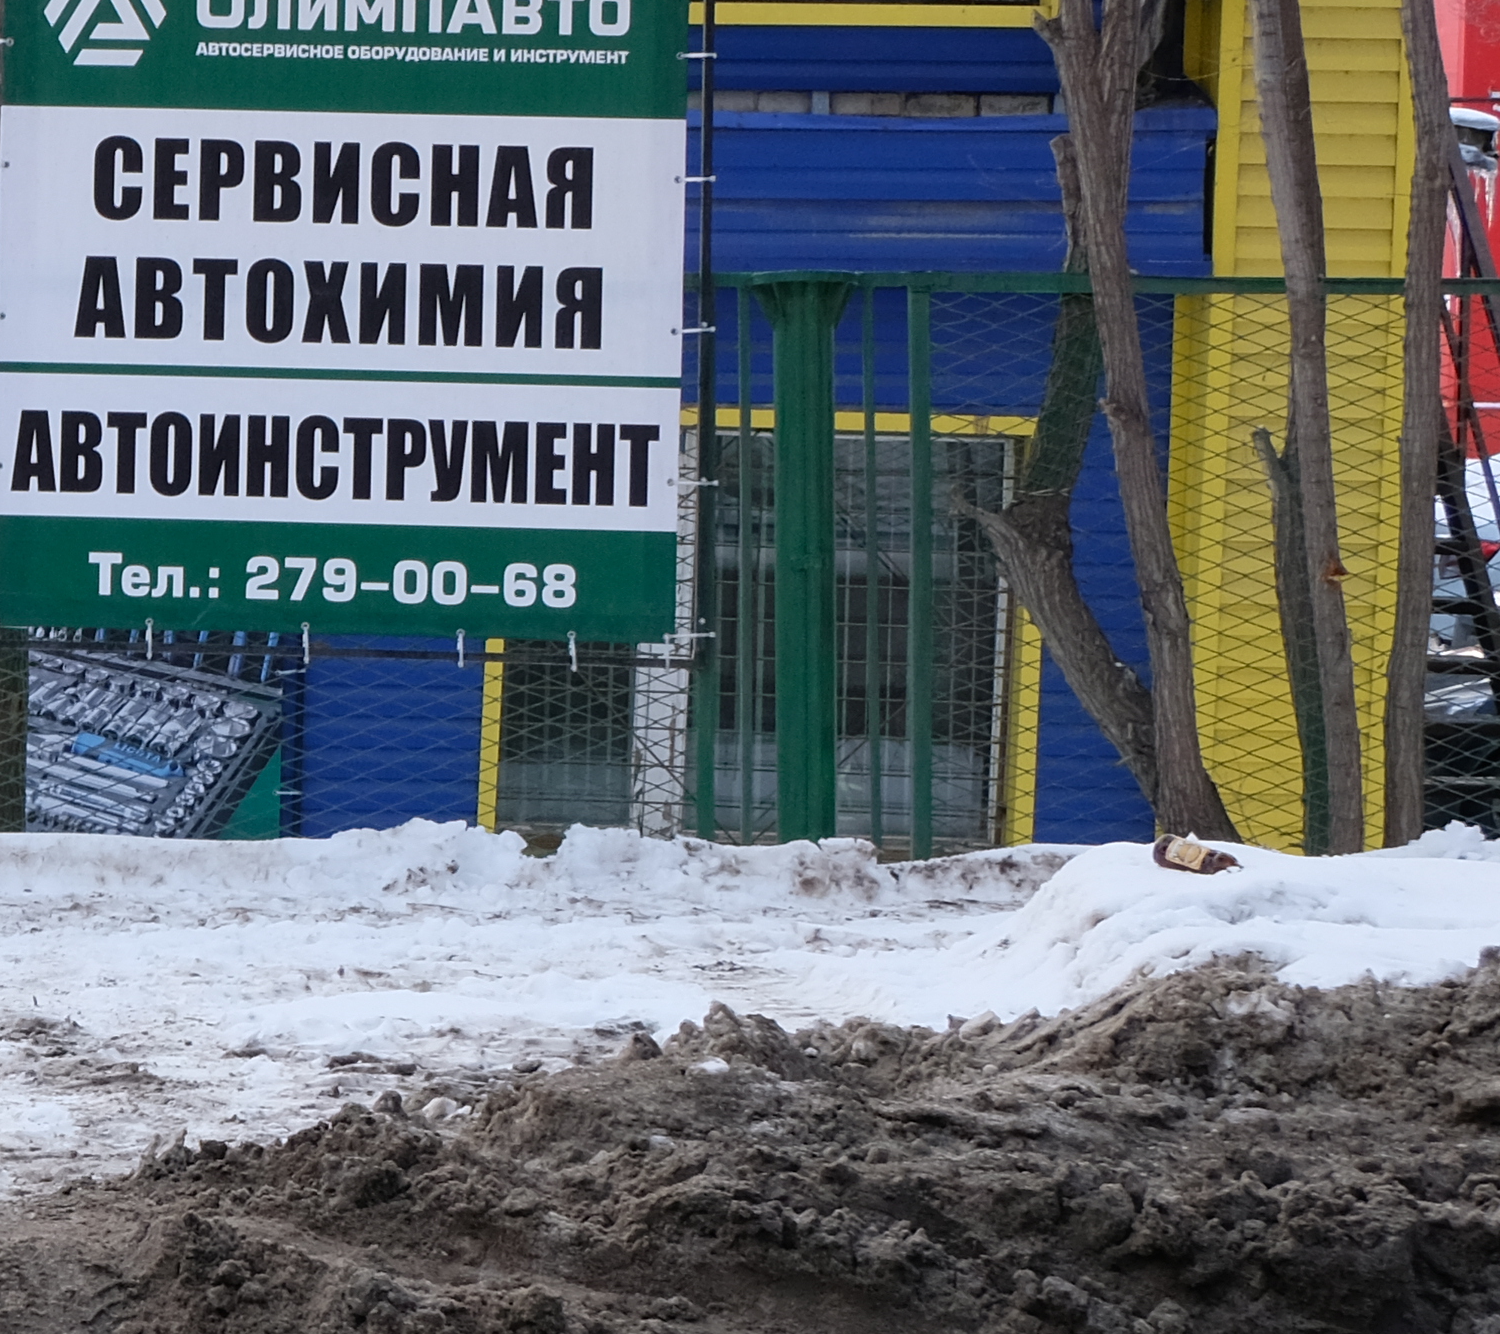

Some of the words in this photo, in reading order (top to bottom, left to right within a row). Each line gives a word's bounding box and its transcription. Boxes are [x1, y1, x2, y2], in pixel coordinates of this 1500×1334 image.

[196, 42, 344, 59] АВТОСЕРВИСНОЕ
[347, 45, 489, 62] ОБОРУДОВАНИЕ
[493, 48, 506, 62] И
[510, 49, 629, 64] ИНСТРУМЕНТ
[93, 135, 594, 230] СЕРВИСНАЯ
[74, 255, 603, 350] АВТОХИМИЯ
[11, 409, 660, 507] АВТОИНСТРУМЕНТ
[88, 551, 220, 599] Тел.:
[244, 556, 576, 609] 279-00-68
